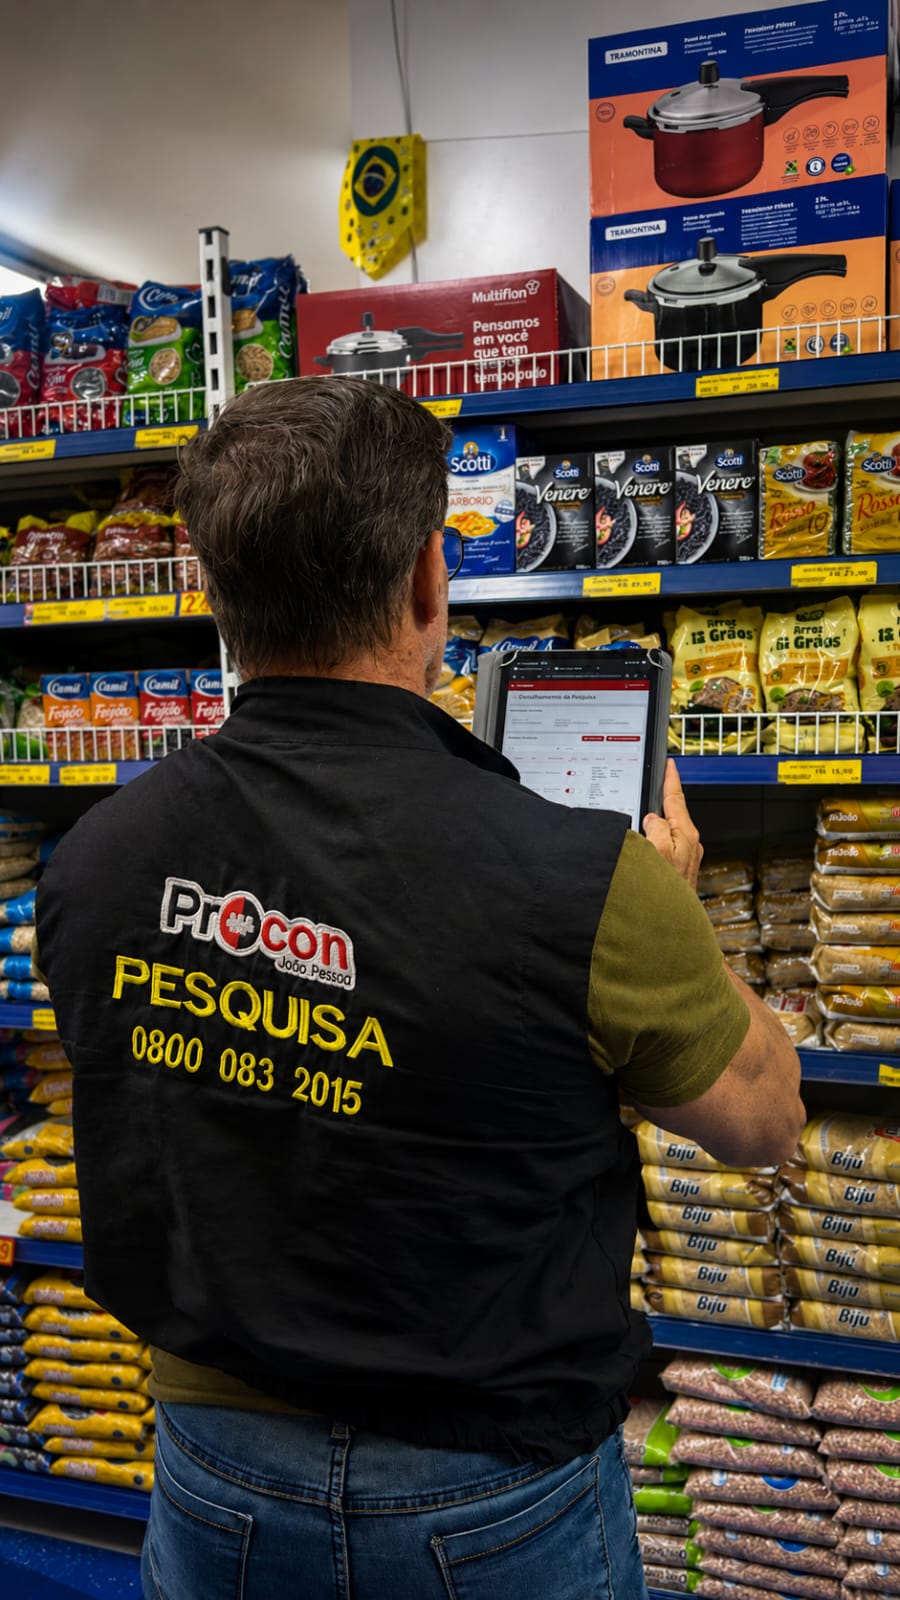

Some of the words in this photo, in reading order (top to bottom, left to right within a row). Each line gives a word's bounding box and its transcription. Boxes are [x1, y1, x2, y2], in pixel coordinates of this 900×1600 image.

[610, 46, 662, 61] TRAMONTINA
[610, 224, 661, 237] TRAMONTINA
[472, 288, 527, 304] Multiflon
[473, 318, 540, 333] Pensamos
[473, 335, 494, 346] em
[497, 328, 529, 343] você
[473, 347, 499, 361] que
[501, 344, 528, 357] tem
[451, 455, 491, 473] Scotti
[635, 461, 659, 473] Scotti
[717, 455, 743, 467] Scotti
[863, 459, 892, 471] Scotti
[555, 468, 579, 479] Scotti
[696, 471, 753, 494] Venere
[775, 469, 803, 481] Scotti
[535, 481, 589, 504] Venere
[614, 476, 670, 500] Venere
[450, 496, 493, 506] ARBORIO
[770, 501, 815, 530] Rosso
[707, 619, 737, 628] Arroz
[793, 626, 823, 635] Arroz
[709, 626, 753, 642] Grãos
[794, 634, 841, 649] Grãos
[51, 681, 82, 694] Camil
[98, 680, 128, 692] Camil
[150, 679, 179, 691] Camil
[200, 678, 223, 689] Cami
[161, 878, 352, 971] Procon
[279, 956, 307, 975] João
[311, 965, 352, 986] Pessoa
[112, 955, 394, 1067] PESQUISA
[132, 1025, 204, 1073] 0800
[219, 1048, 275, 1092] 083
[291, 1066, 363, 1116] 2015
[666, 1142, 696, 1162] Biju
[831, 1151, 863, 1171] Biju
[670, 1178, 700, 1197] Biju
[843, 1186, 876, 1206] Biju
[681, 1206, 712, 1225] Biju
[821, 1215, 853, 1235] Biju
[686, 1233, 718, 1253] Biju
[824, 1248, 856, 1269] Biju
[697, 1266, 728, 1285] Biju
[827, 1278, 859, 1299] Biju
[696, 1295, 727, 1316] Biju
[838, 1307, 870, 1328] Biju
